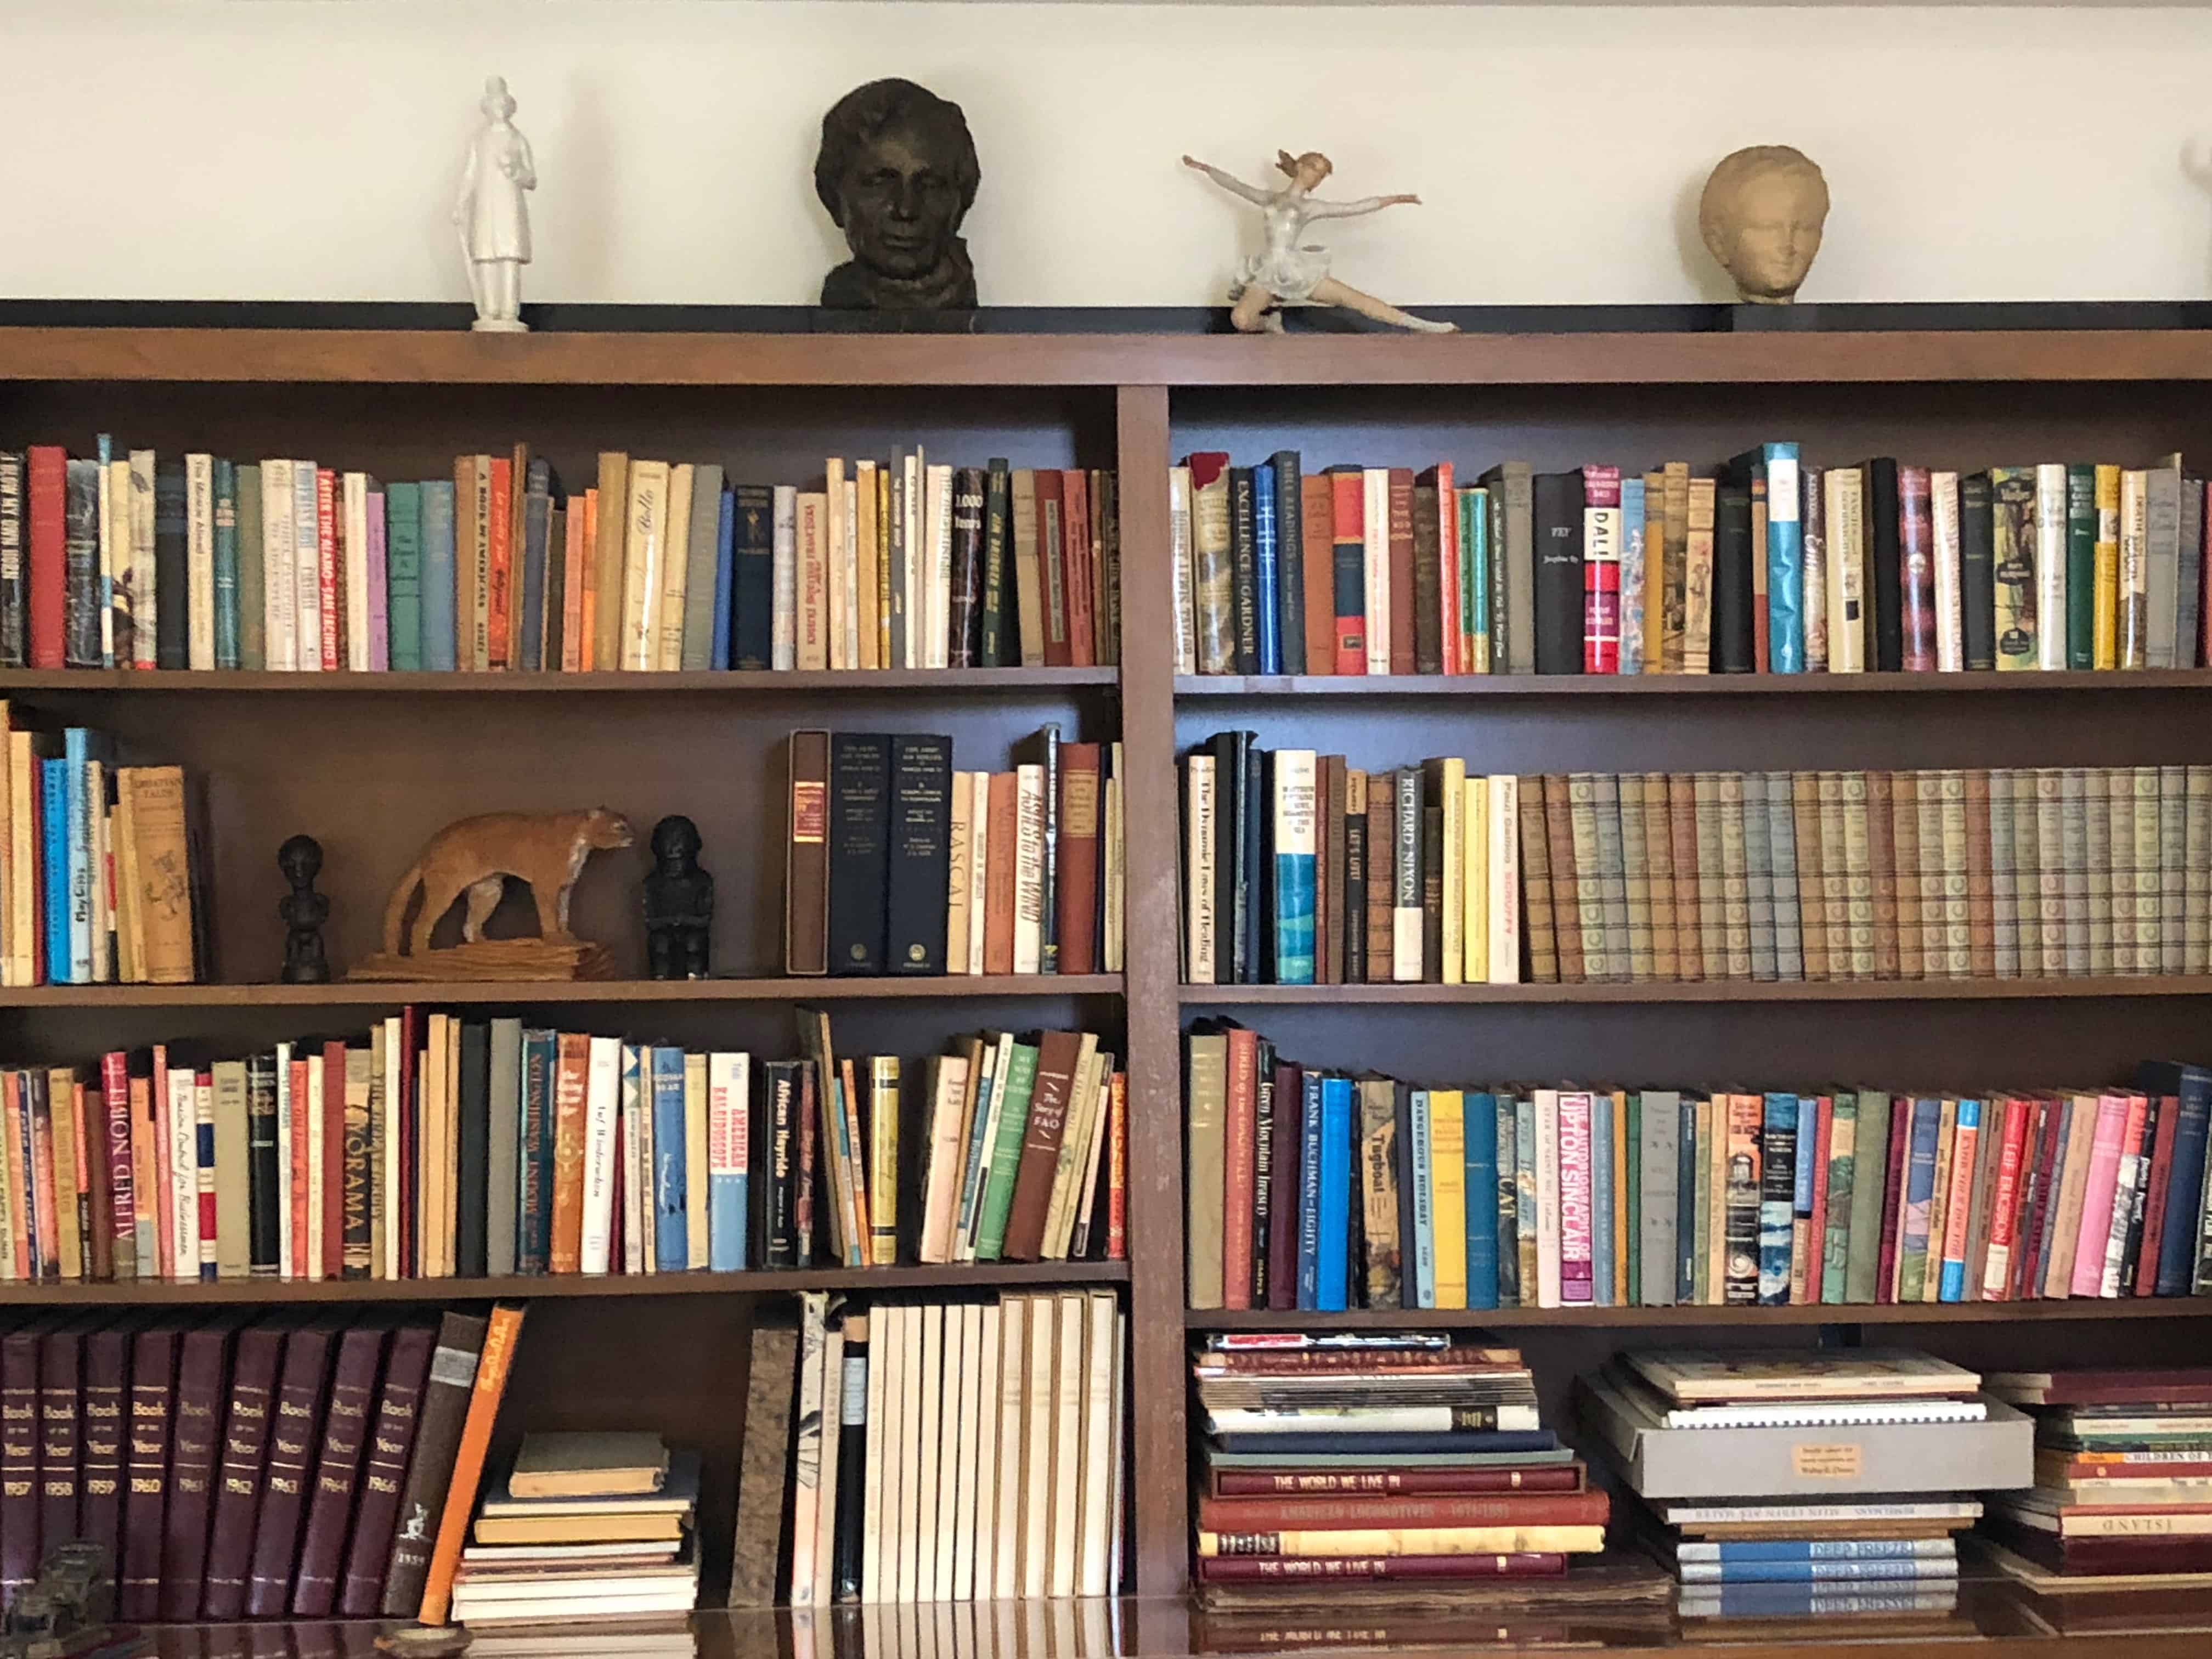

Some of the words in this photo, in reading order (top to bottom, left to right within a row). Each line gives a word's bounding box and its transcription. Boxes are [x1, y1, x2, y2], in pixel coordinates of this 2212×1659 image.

[319, 477, 331, 512] AFTER
[320, 515, 332, 537] THE
[1238, 480, 1251, 572] EXCELLENCE
[1241, 584, 1255, 655] GARDNER
[1021, 789, 1043, 839] ASHES
[1402, 778, 1415, 845] RICHARD
[1021, 856, 1042, 878] the
[1402, 851, 1415, 901] NIXON
[1020, 879, 1041, 923] WIND
[527, 1053, 543, 1153] WASHINGTON
[777, 1080, 791, 1126] African
[1308, 1085, 1319, 1127] FRANK
[1577, 1098, 1589, 1124] THE
[109, 1085, 131, 1157] NOBEL
[712, 1086, 728, 1169] KALEIDOSCOPE
[1559, 1097, 1580, 1164] UPTON
[731, 1108, 748, 1169] AMERICAN
[1416, 1099, 1426, 1170] DANGEROUS
[775, 1129, 790, 1178] Hayride
[1369, 1133, 1386, 1193] Tugboat
[2002, 1142, 2018, 1169] LEIF
[1577, 1127, 1589, 1238] AUTOBIOGRAPHY
[112, 1164, 135, 1242] ALFRED
[1419, 1174, 1428, 1226] HOLIDAY
[1499, 1177, 1515, 1219] CAT
[1560, 1169, 1581, 1260] SINCLAIR
[1577, 1241, 1590, 1260] OF
[3, 1403, 35, 1419] Book
[43, 1403, 76, 1419] Book
[87, 1401, 121, 1418] Book
[132, 1400, 167, 1417] Book
[180, 1401, 212, 1417] Book
[233, 1400, 264, 1418] Book
[279, 1401, 312, 1419] Book
[331, 1399, 364, 1418] Book
[381, 1399, 414, 1418] Book
[4, 1442, 33, 1456] Year
[44, 1442, 72, 1457] Year
[87, 1439, 118, 1454] Year
[132, 1438, 163, 1453] Year
[180, 1438, 207, 1453] Year
[229, 1438, 259, 1454] Year
[276, 1438, 304, 1454] Year
[326, 1436, 356, 1453] Year
[376, 1436, 404, 1454] Year
[44, 1482, 74, 1496] 1958
[131, 1477, 162, 1493] 1960
[225, 1478, 254, 1495] 1962
[1274, 1475, 1294, 1489] THE
[1298, 1475, 1336, 1489] WORLD
[1340, 1475, 1357, 1489] WE
[1361, 1474, 1384, 1488] LIVE
[1388, 1474, 1401, 1488] IN
[1279, 1505, 1343, 1521] AMERICAN
[1350, 1504, 1435, 1520] LOCOMOTIVES
[2102, 1518, 2172, 1533] ISLAND
[1814, 1543, 1852, 1558] DEEP
[1259, 1561, 1279, 1575] THE
[1283, 1561, 1321, 1575] WORLD
[1325, 1561, 1342, 1574] WE
[1346, 1560, 1369, 1573] LIVE
[1373, 1560, 1386, 1573] IN
